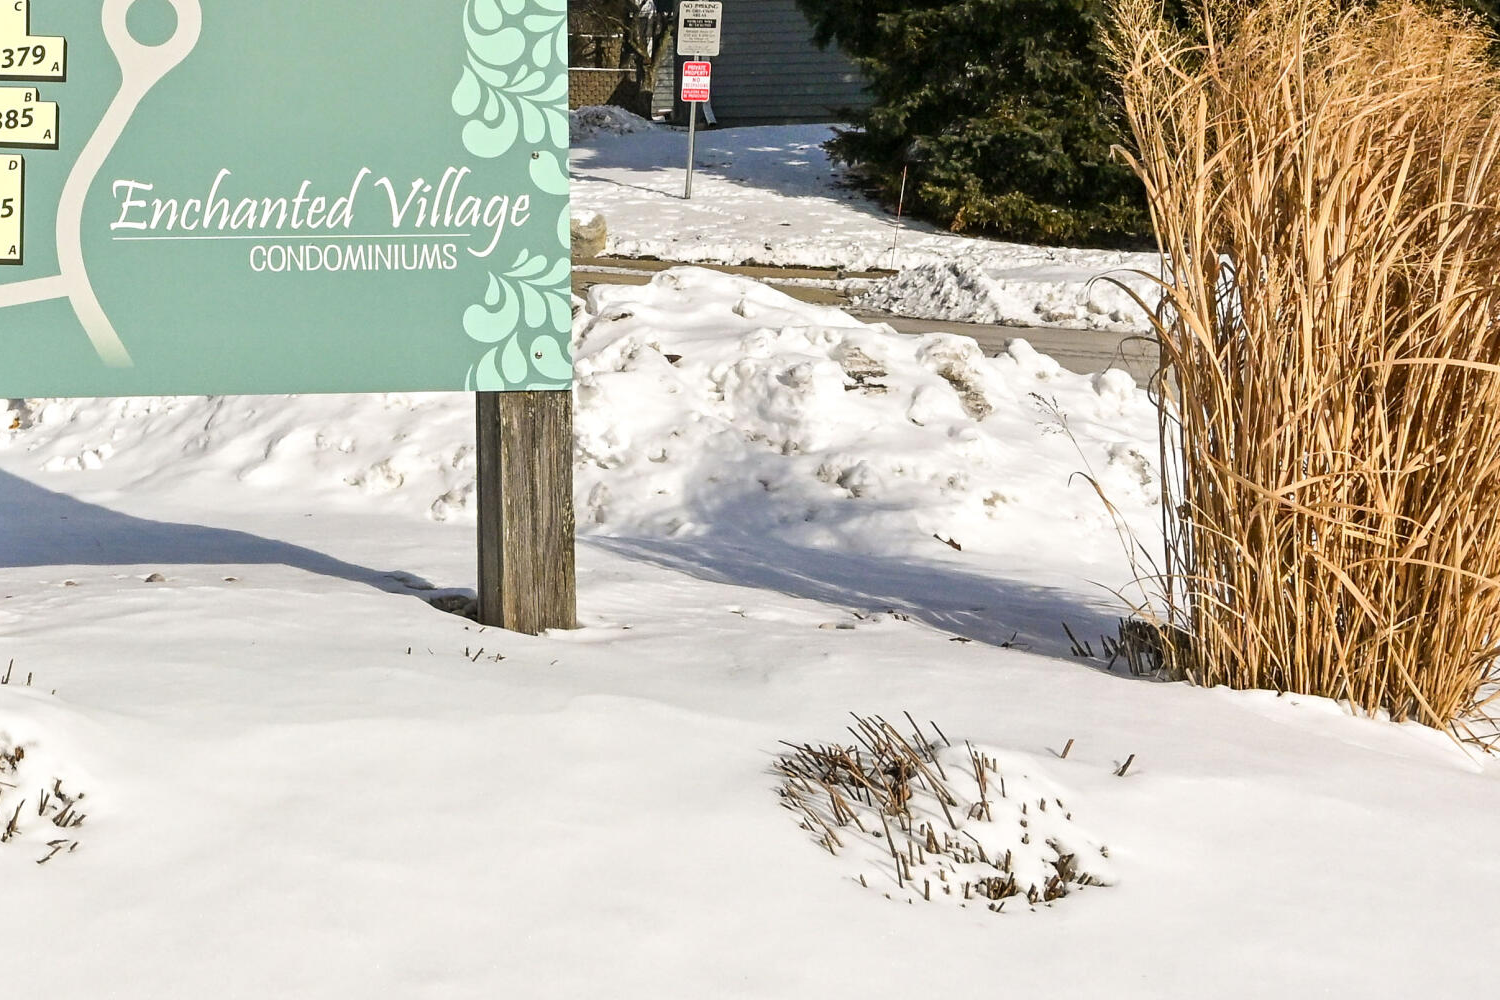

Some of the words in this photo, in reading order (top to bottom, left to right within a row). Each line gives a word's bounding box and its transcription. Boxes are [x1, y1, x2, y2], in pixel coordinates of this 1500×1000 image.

[14, 1, 23, 12] C
[1, 44, 46, 69] 379
[50, 61, 60, 72] A
[24, 91, 33, 103] B
[43, 128, 52, 140] A
[8, 159, 18, 171] D
[110, 167, 371, 231] Enchanted
[374, 166, 531, 258] Village
[8, 244, 17, 255] A
[249, 243, 458, 272] CONDOMINIUMS
